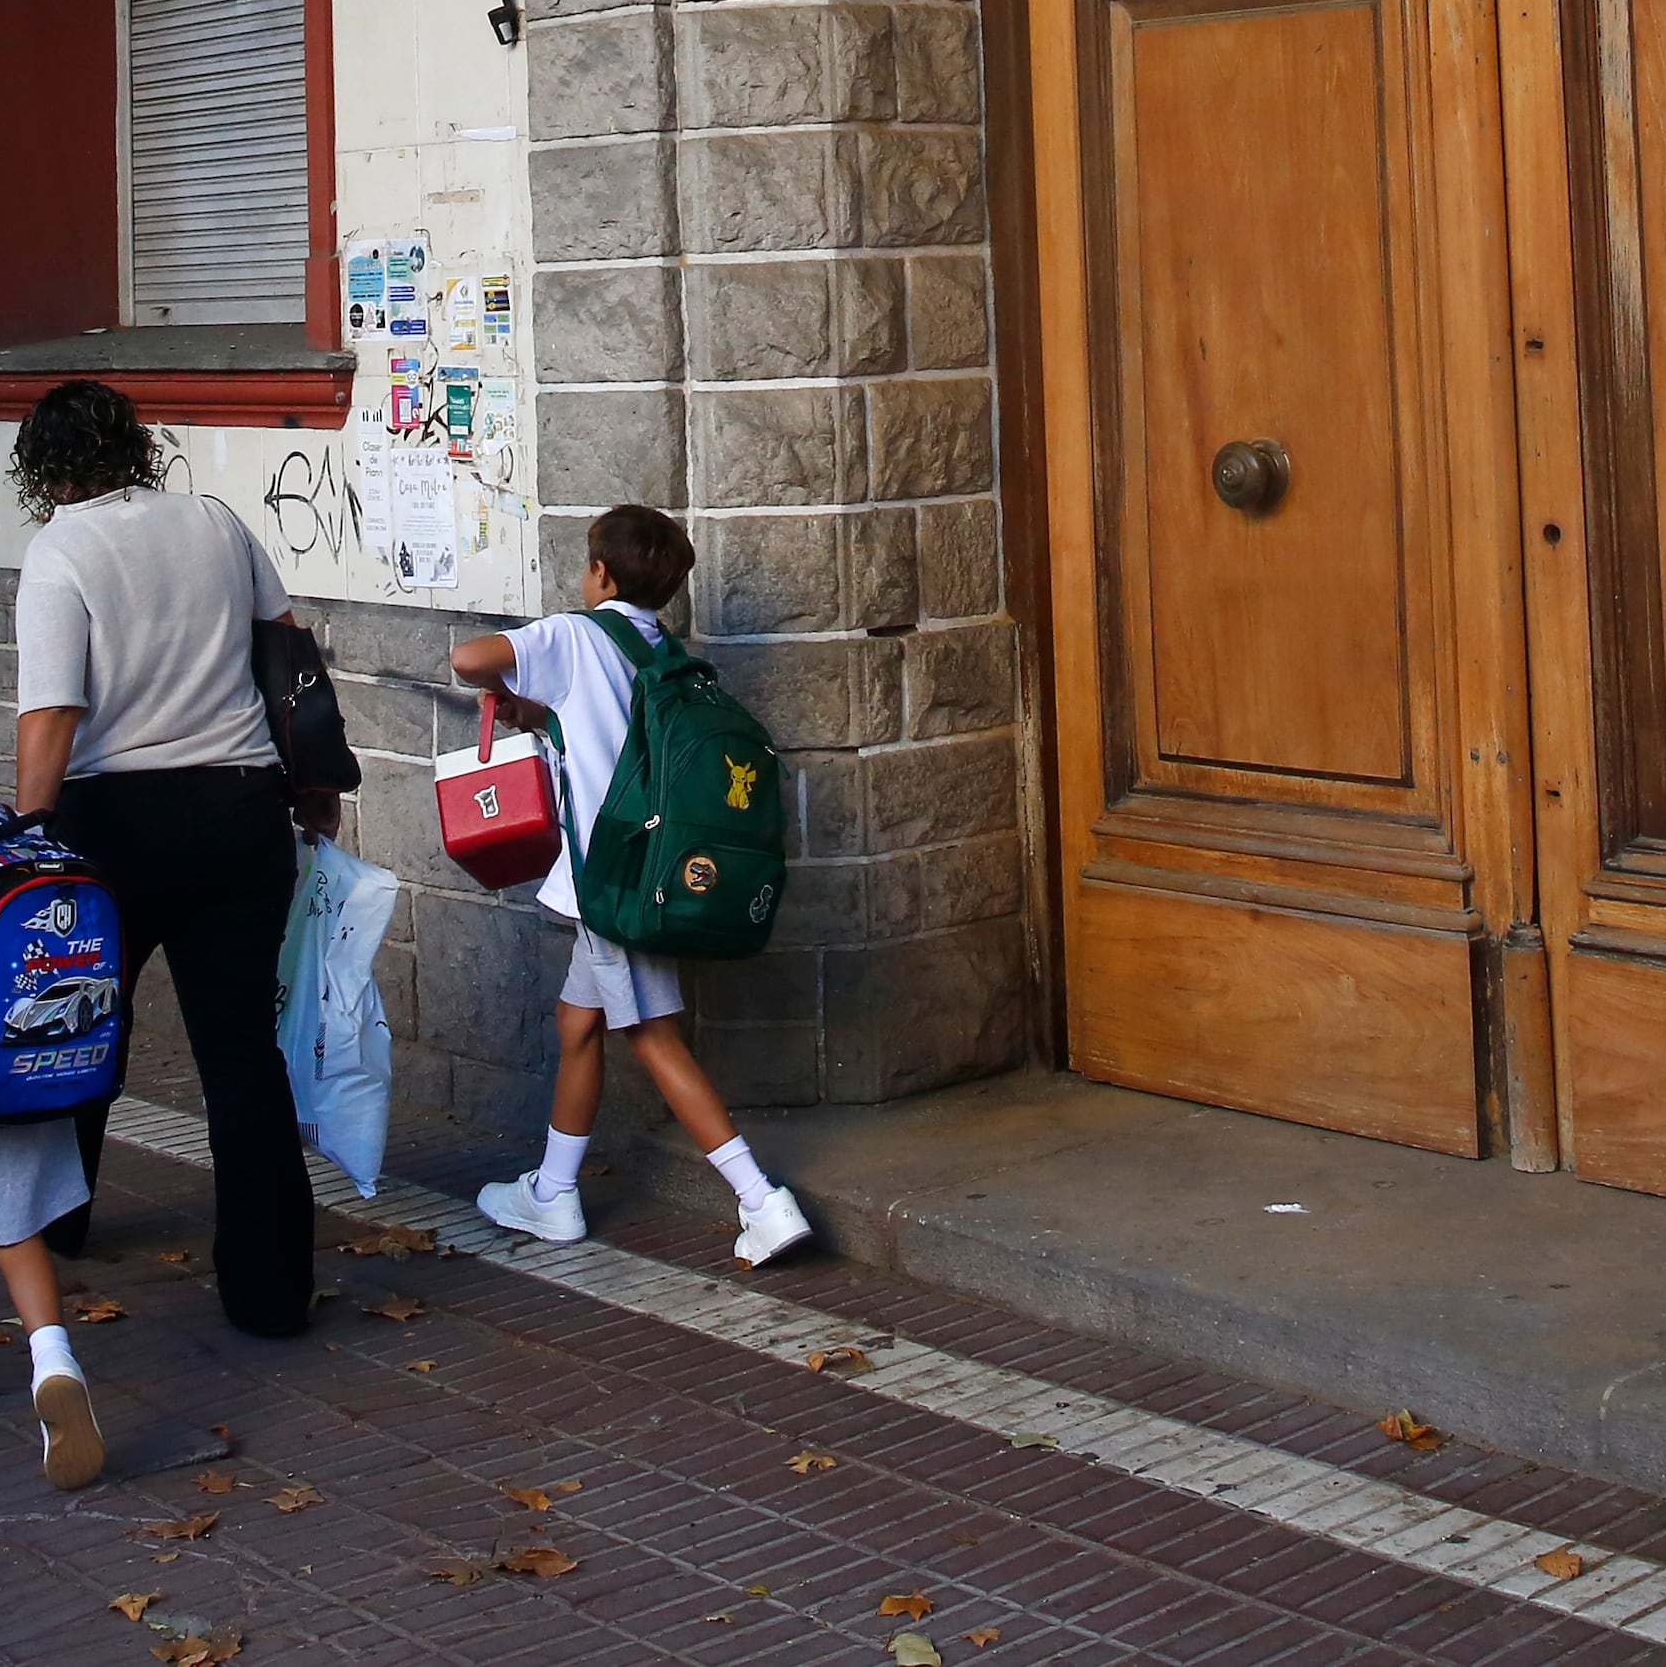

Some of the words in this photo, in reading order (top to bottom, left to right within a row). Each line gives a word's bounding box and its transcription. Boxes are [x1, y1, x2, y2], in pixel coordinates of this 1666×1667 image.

[67, 937, 104, 954] THE
[25, 950, 102, 973] POWER
[92, 961, 107, 972] OF
[9, 1042, 110, 1075] SPEED
